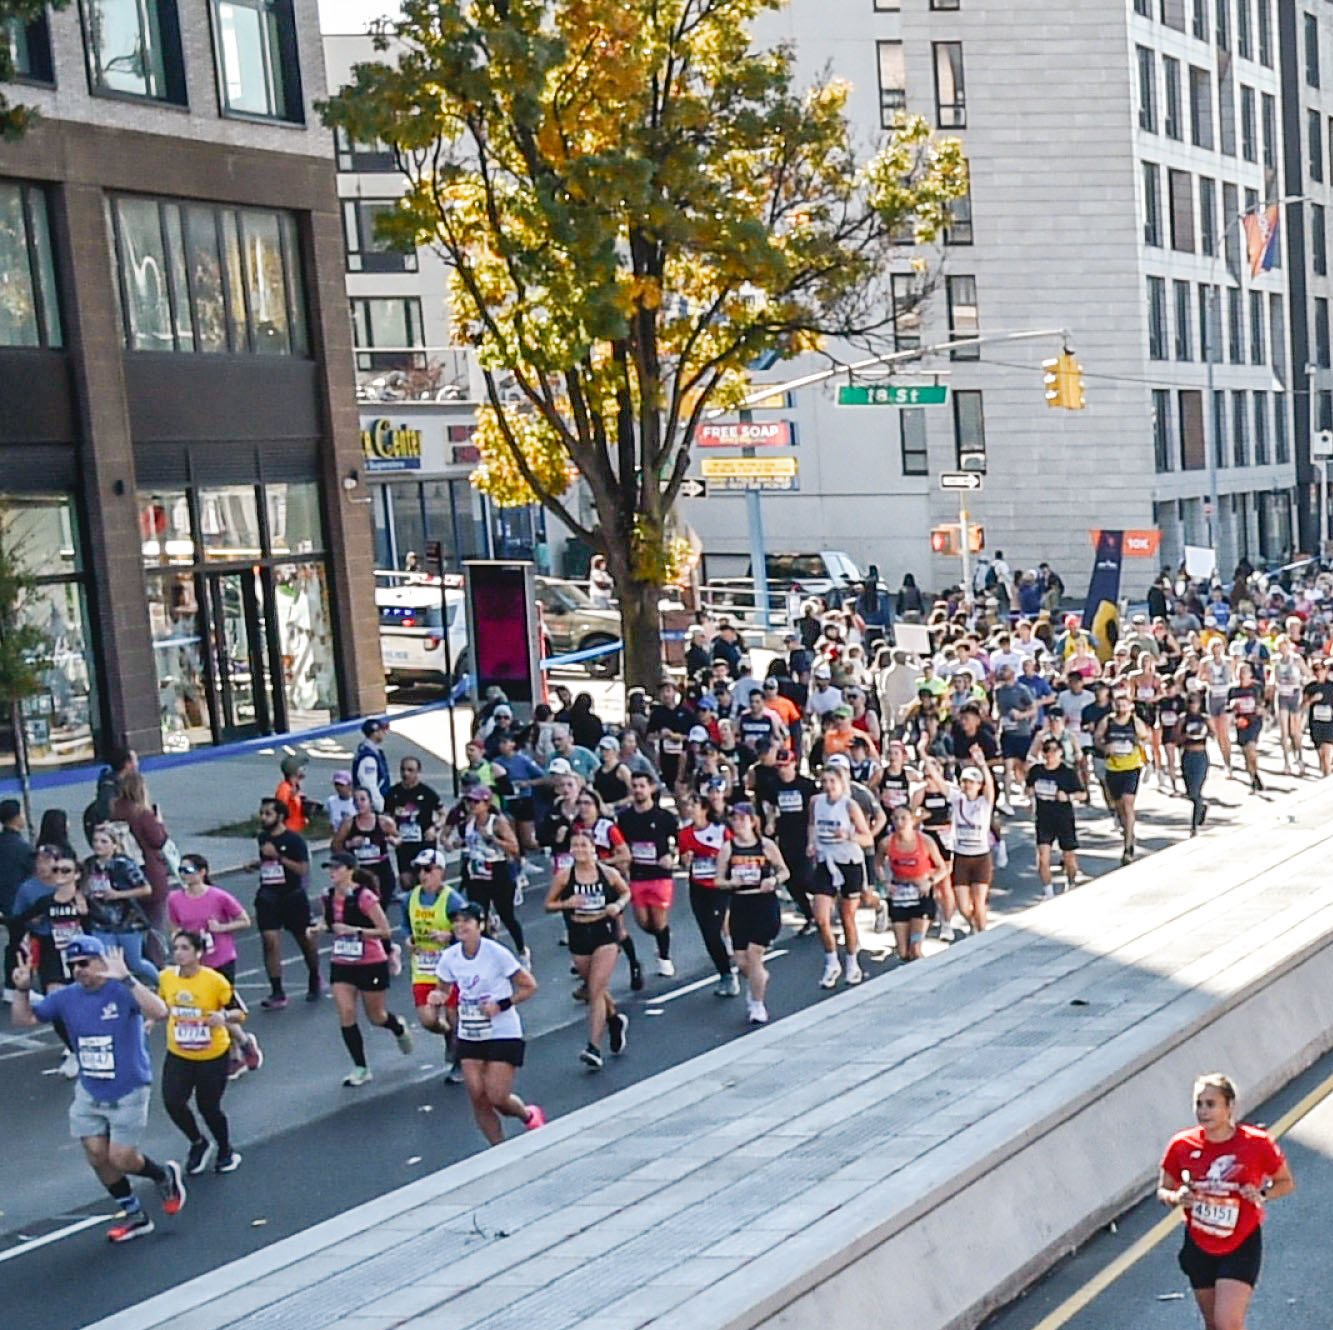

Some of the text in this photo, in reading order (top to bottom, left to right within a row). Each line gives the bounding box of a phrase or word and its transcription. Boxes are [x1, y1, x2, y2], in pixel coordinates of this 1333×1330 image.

[894, 388, 920, 403] St
[702, 424, 780, 438] FREE SOAP
[1195, 1204, 1233, 1222] 45151
